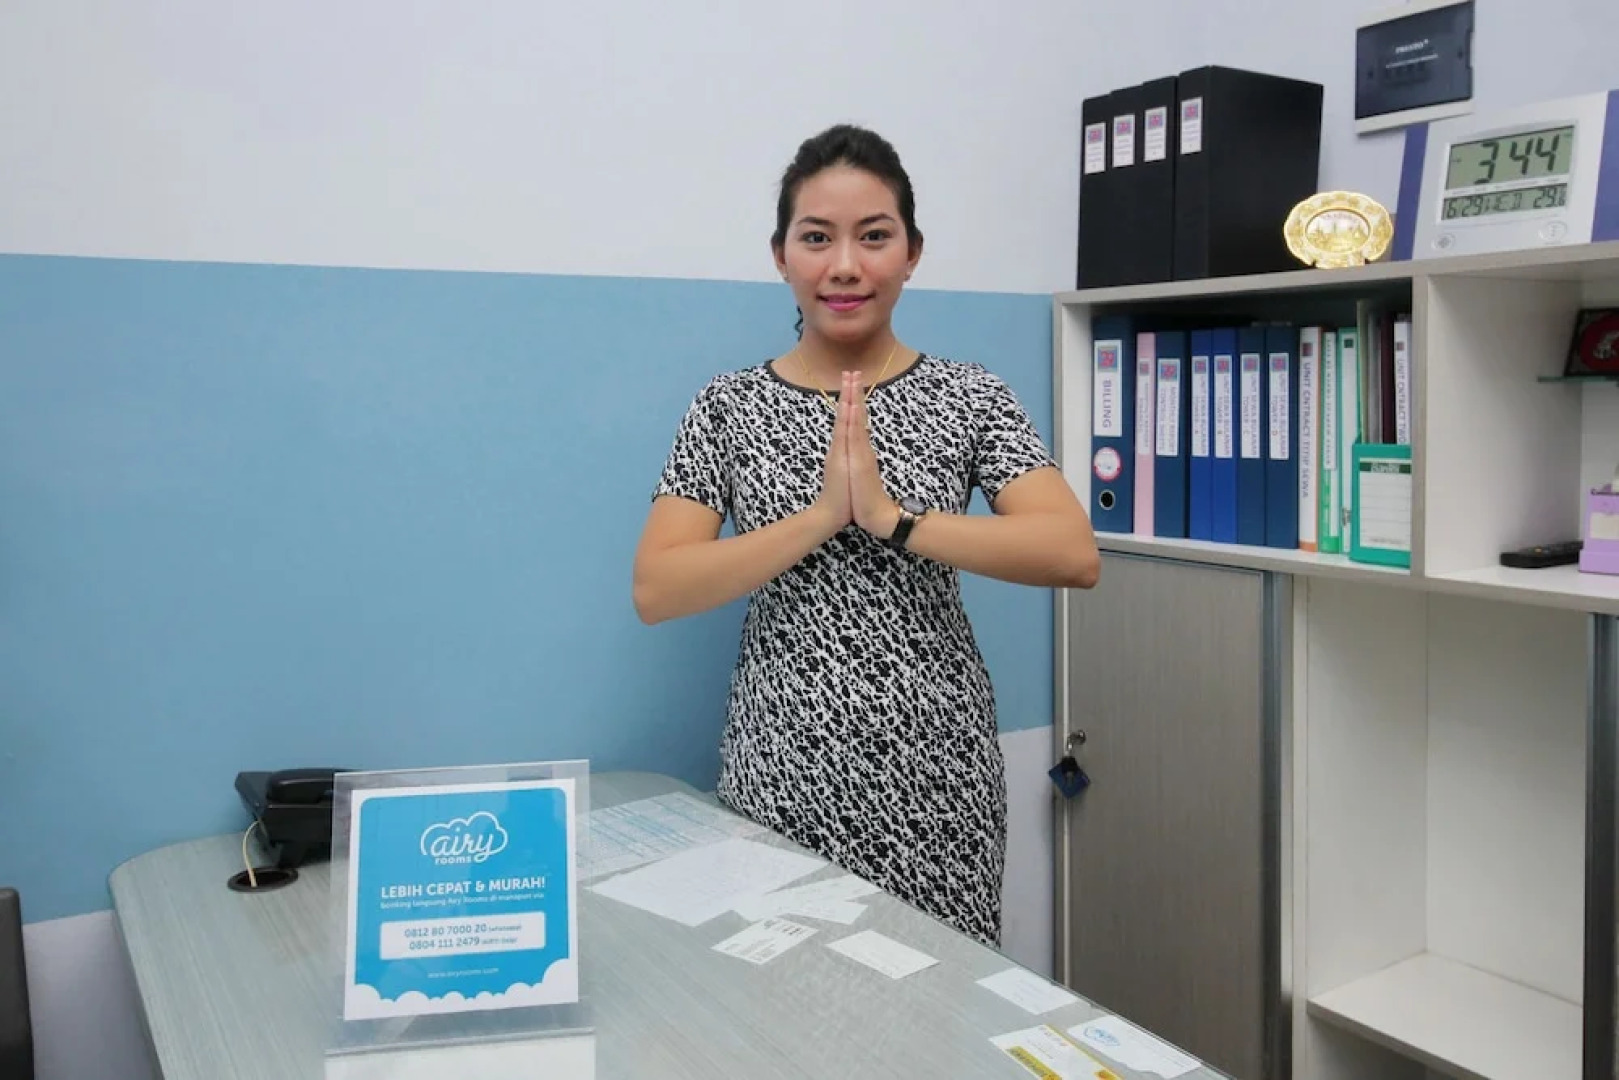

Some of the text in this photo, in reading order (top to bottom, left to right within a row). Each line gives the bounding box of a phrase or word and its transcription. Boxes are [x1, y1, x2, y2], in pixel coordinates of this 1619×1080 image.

[1303, 362, 1311, 387] UNIT
[1397, 359, 1405, 380] UNIT
[1102, 380, 1112, 428] BILLING
[1303, 390, 1311, 437] CNTRACT
[430, 827, 495, 865] airy
[434, 855, 472, 866] rooms
[380, 876, 546, 899] LEBIH CEPAT & MURAH!
[404, 928, 429, 938] 0812
[431, 926, 445, 937] 80
[446, 925, 473, 935] 7000
[475, 923, 488, 933] 20
[409, 940, 435, 950] 0804
[437, 939, 454, 948] 111
[456, 936, 481, 948] 2479
